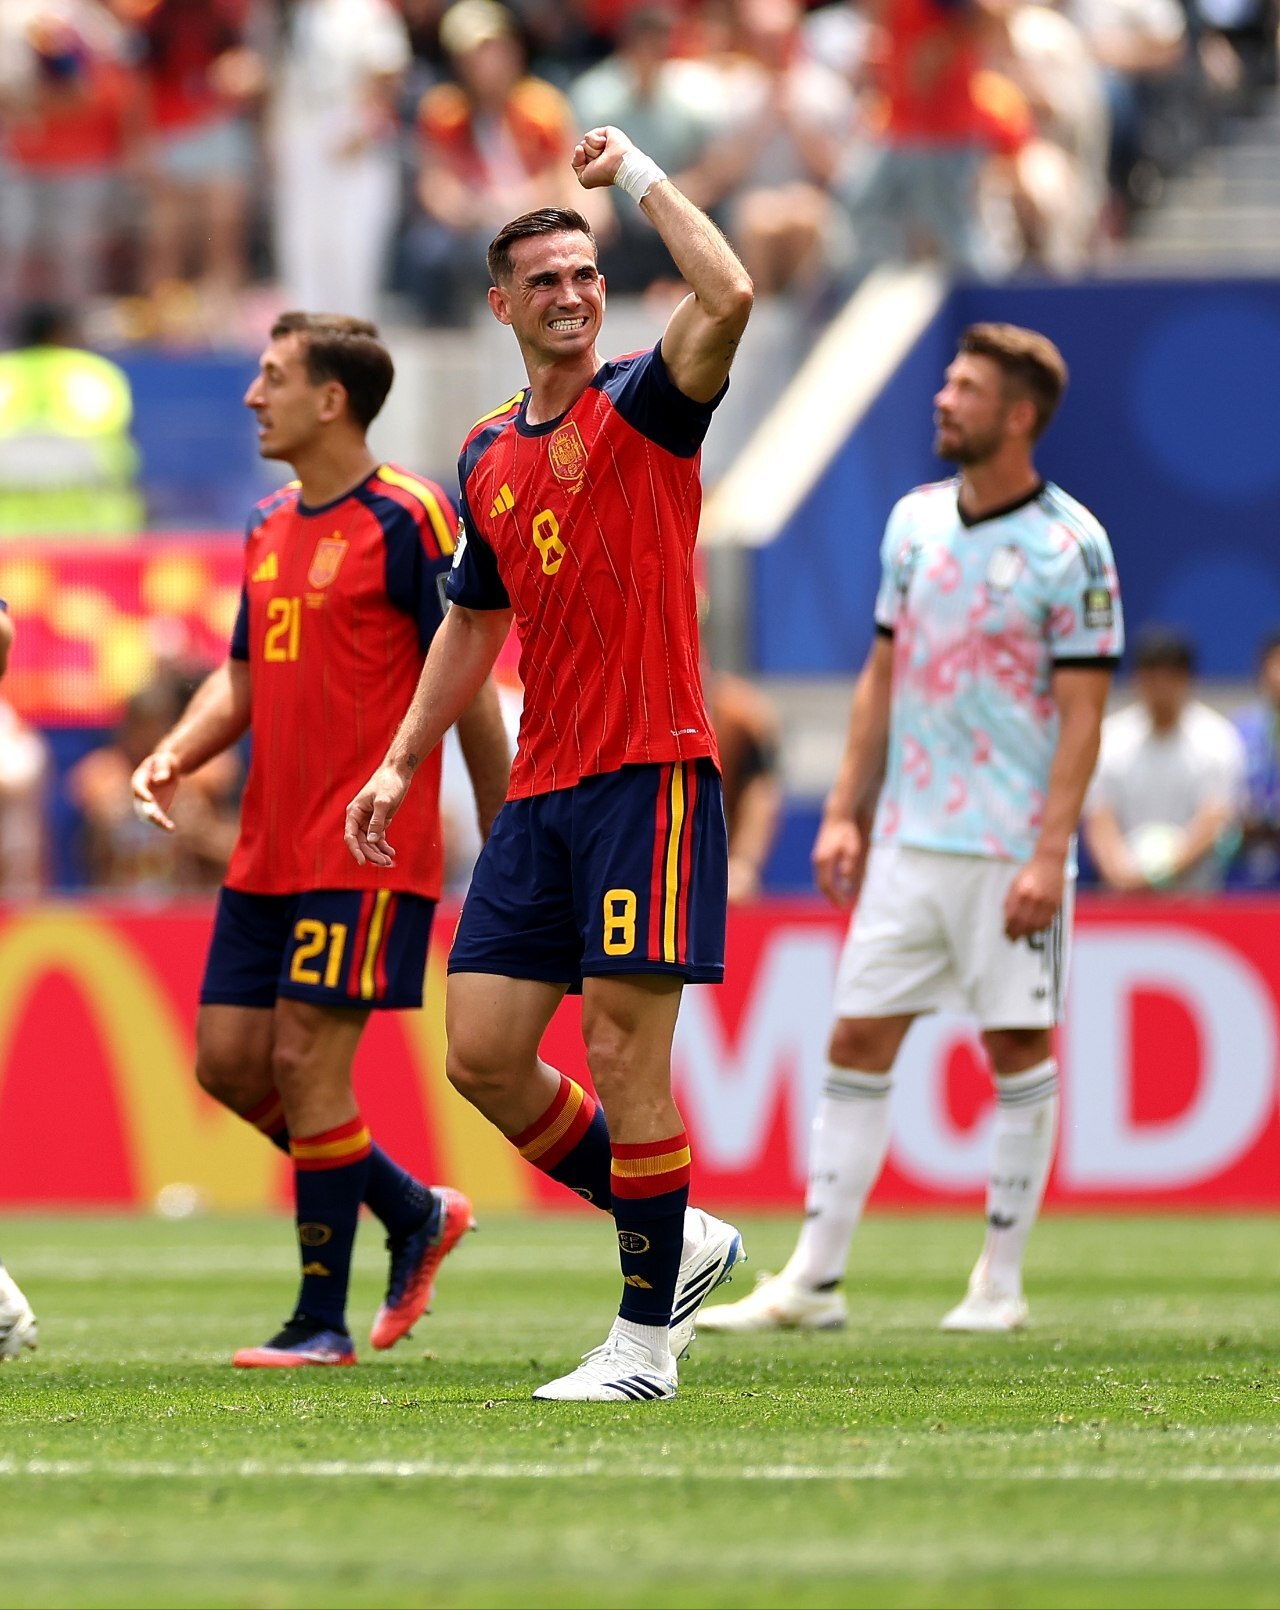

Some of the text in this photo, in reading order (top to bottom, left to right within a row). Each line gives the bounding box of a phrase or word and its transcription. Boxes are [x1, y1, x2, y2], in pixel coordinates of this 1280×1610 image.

[533, 509, 566, 575] 8
[265, 597, 300, 661] 21
[290, 918, 347, 987] 21
[604, 889, 636, 955] 8
